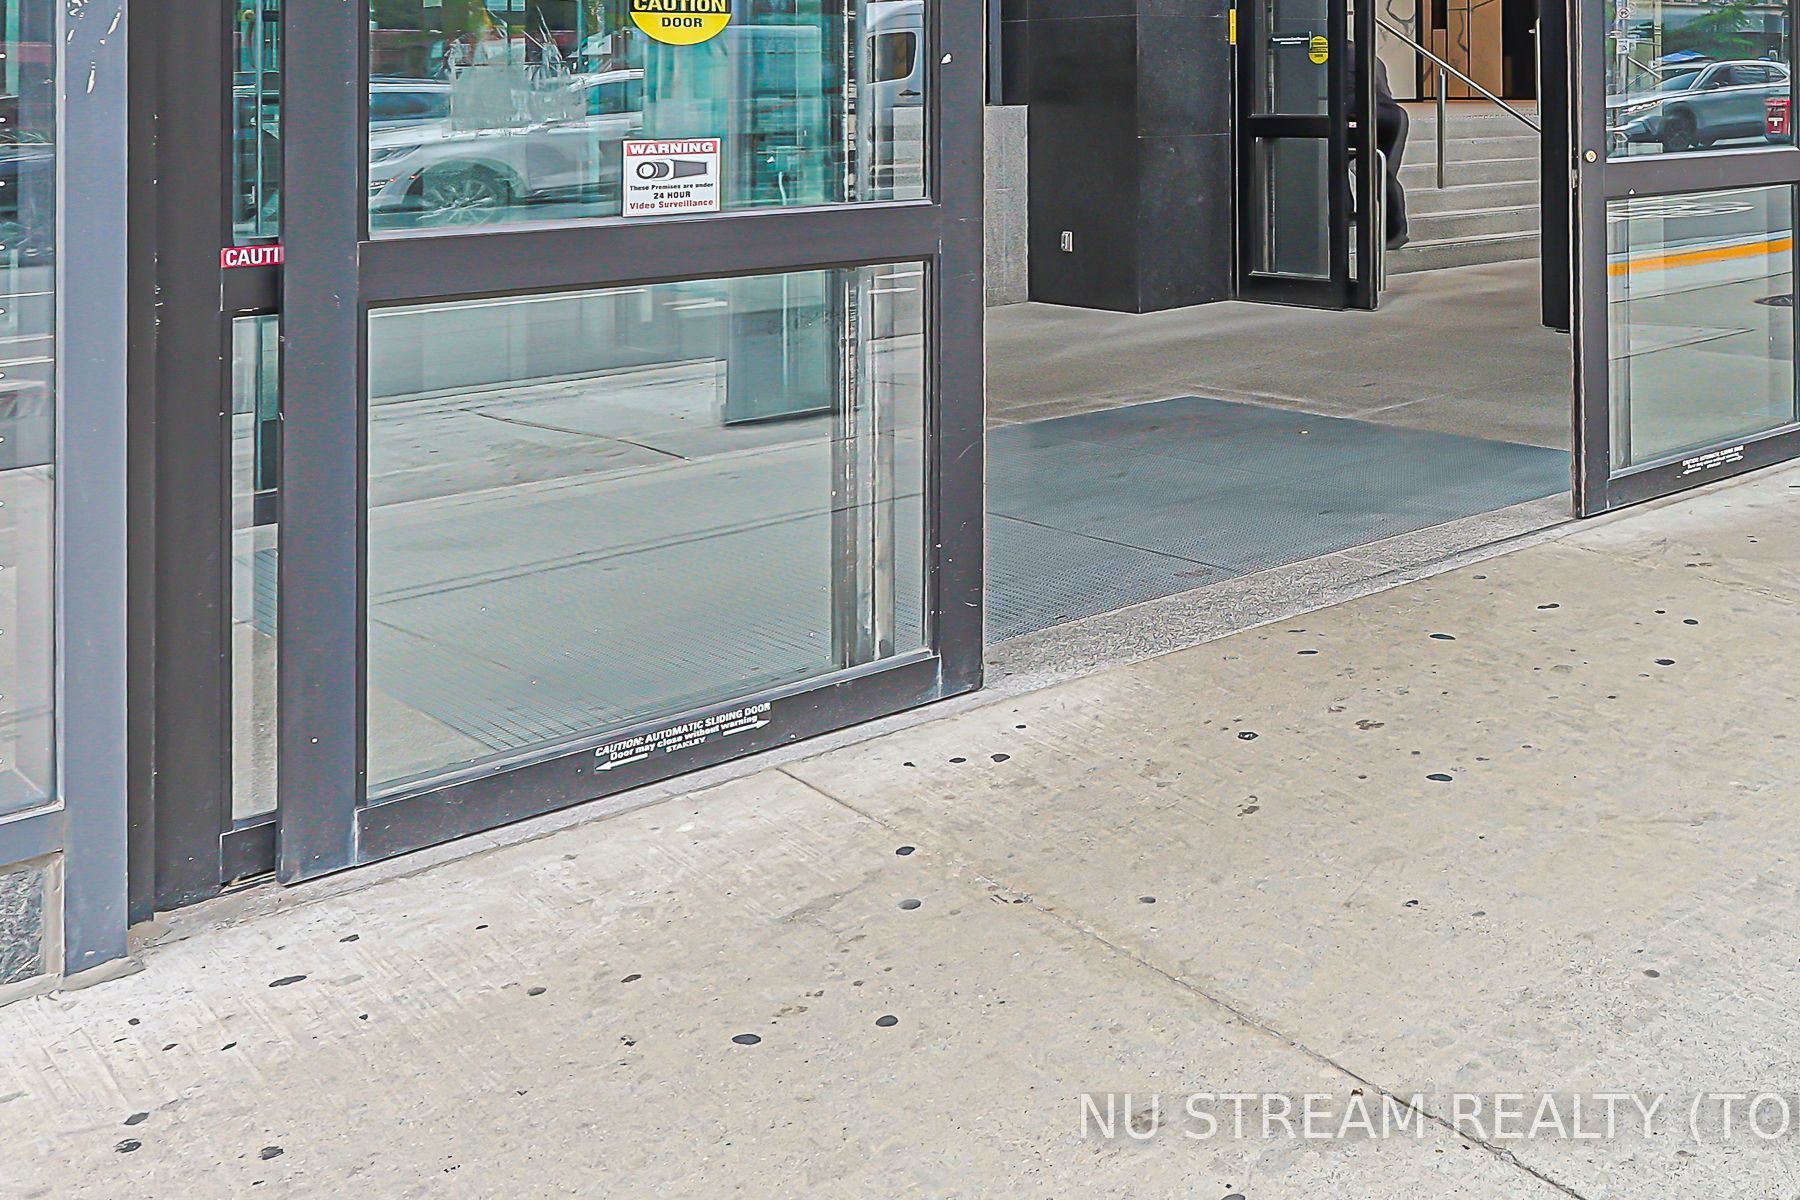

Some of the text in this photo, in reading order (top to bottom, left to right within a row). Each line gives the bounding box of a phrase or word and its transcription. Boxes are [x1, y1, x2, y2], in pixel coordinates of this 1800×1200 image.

[661, 17, 703, 28] DOOR
[629, 142, 714, 155] WARNING
[667, 191, 691, 199] HOUR
[658, 199, 714, 208] Surveillance
[595, 702, 771, 757] CAUTION: AUTOMATIC SLIDING DOOR
[610, 715, 758, 761] Door may close without warning
